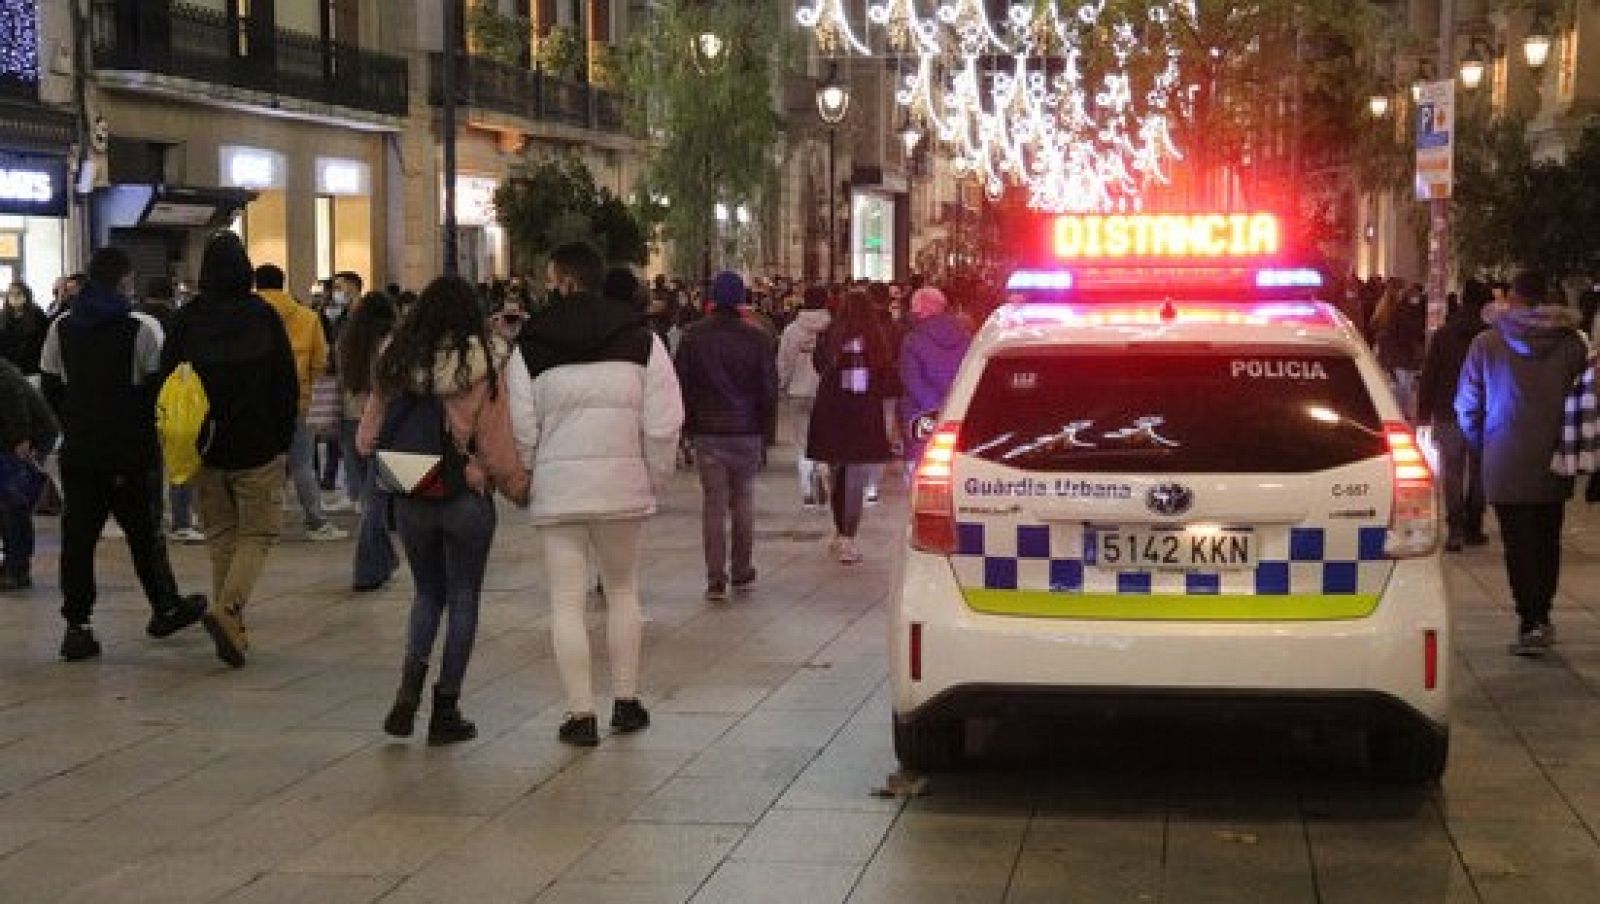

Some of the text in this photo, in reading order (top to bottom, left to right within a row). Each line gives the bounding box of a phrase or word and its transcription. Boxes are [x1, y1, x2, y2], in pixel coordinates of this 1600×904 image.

[1055, 213, 1279, 257] DISTANCIA
[1232, 361, 1328, 380] POLICIA
[1054, 479, 1132, 499] Urbana
[1103, 533, 1248, 564] 5142 KKN
